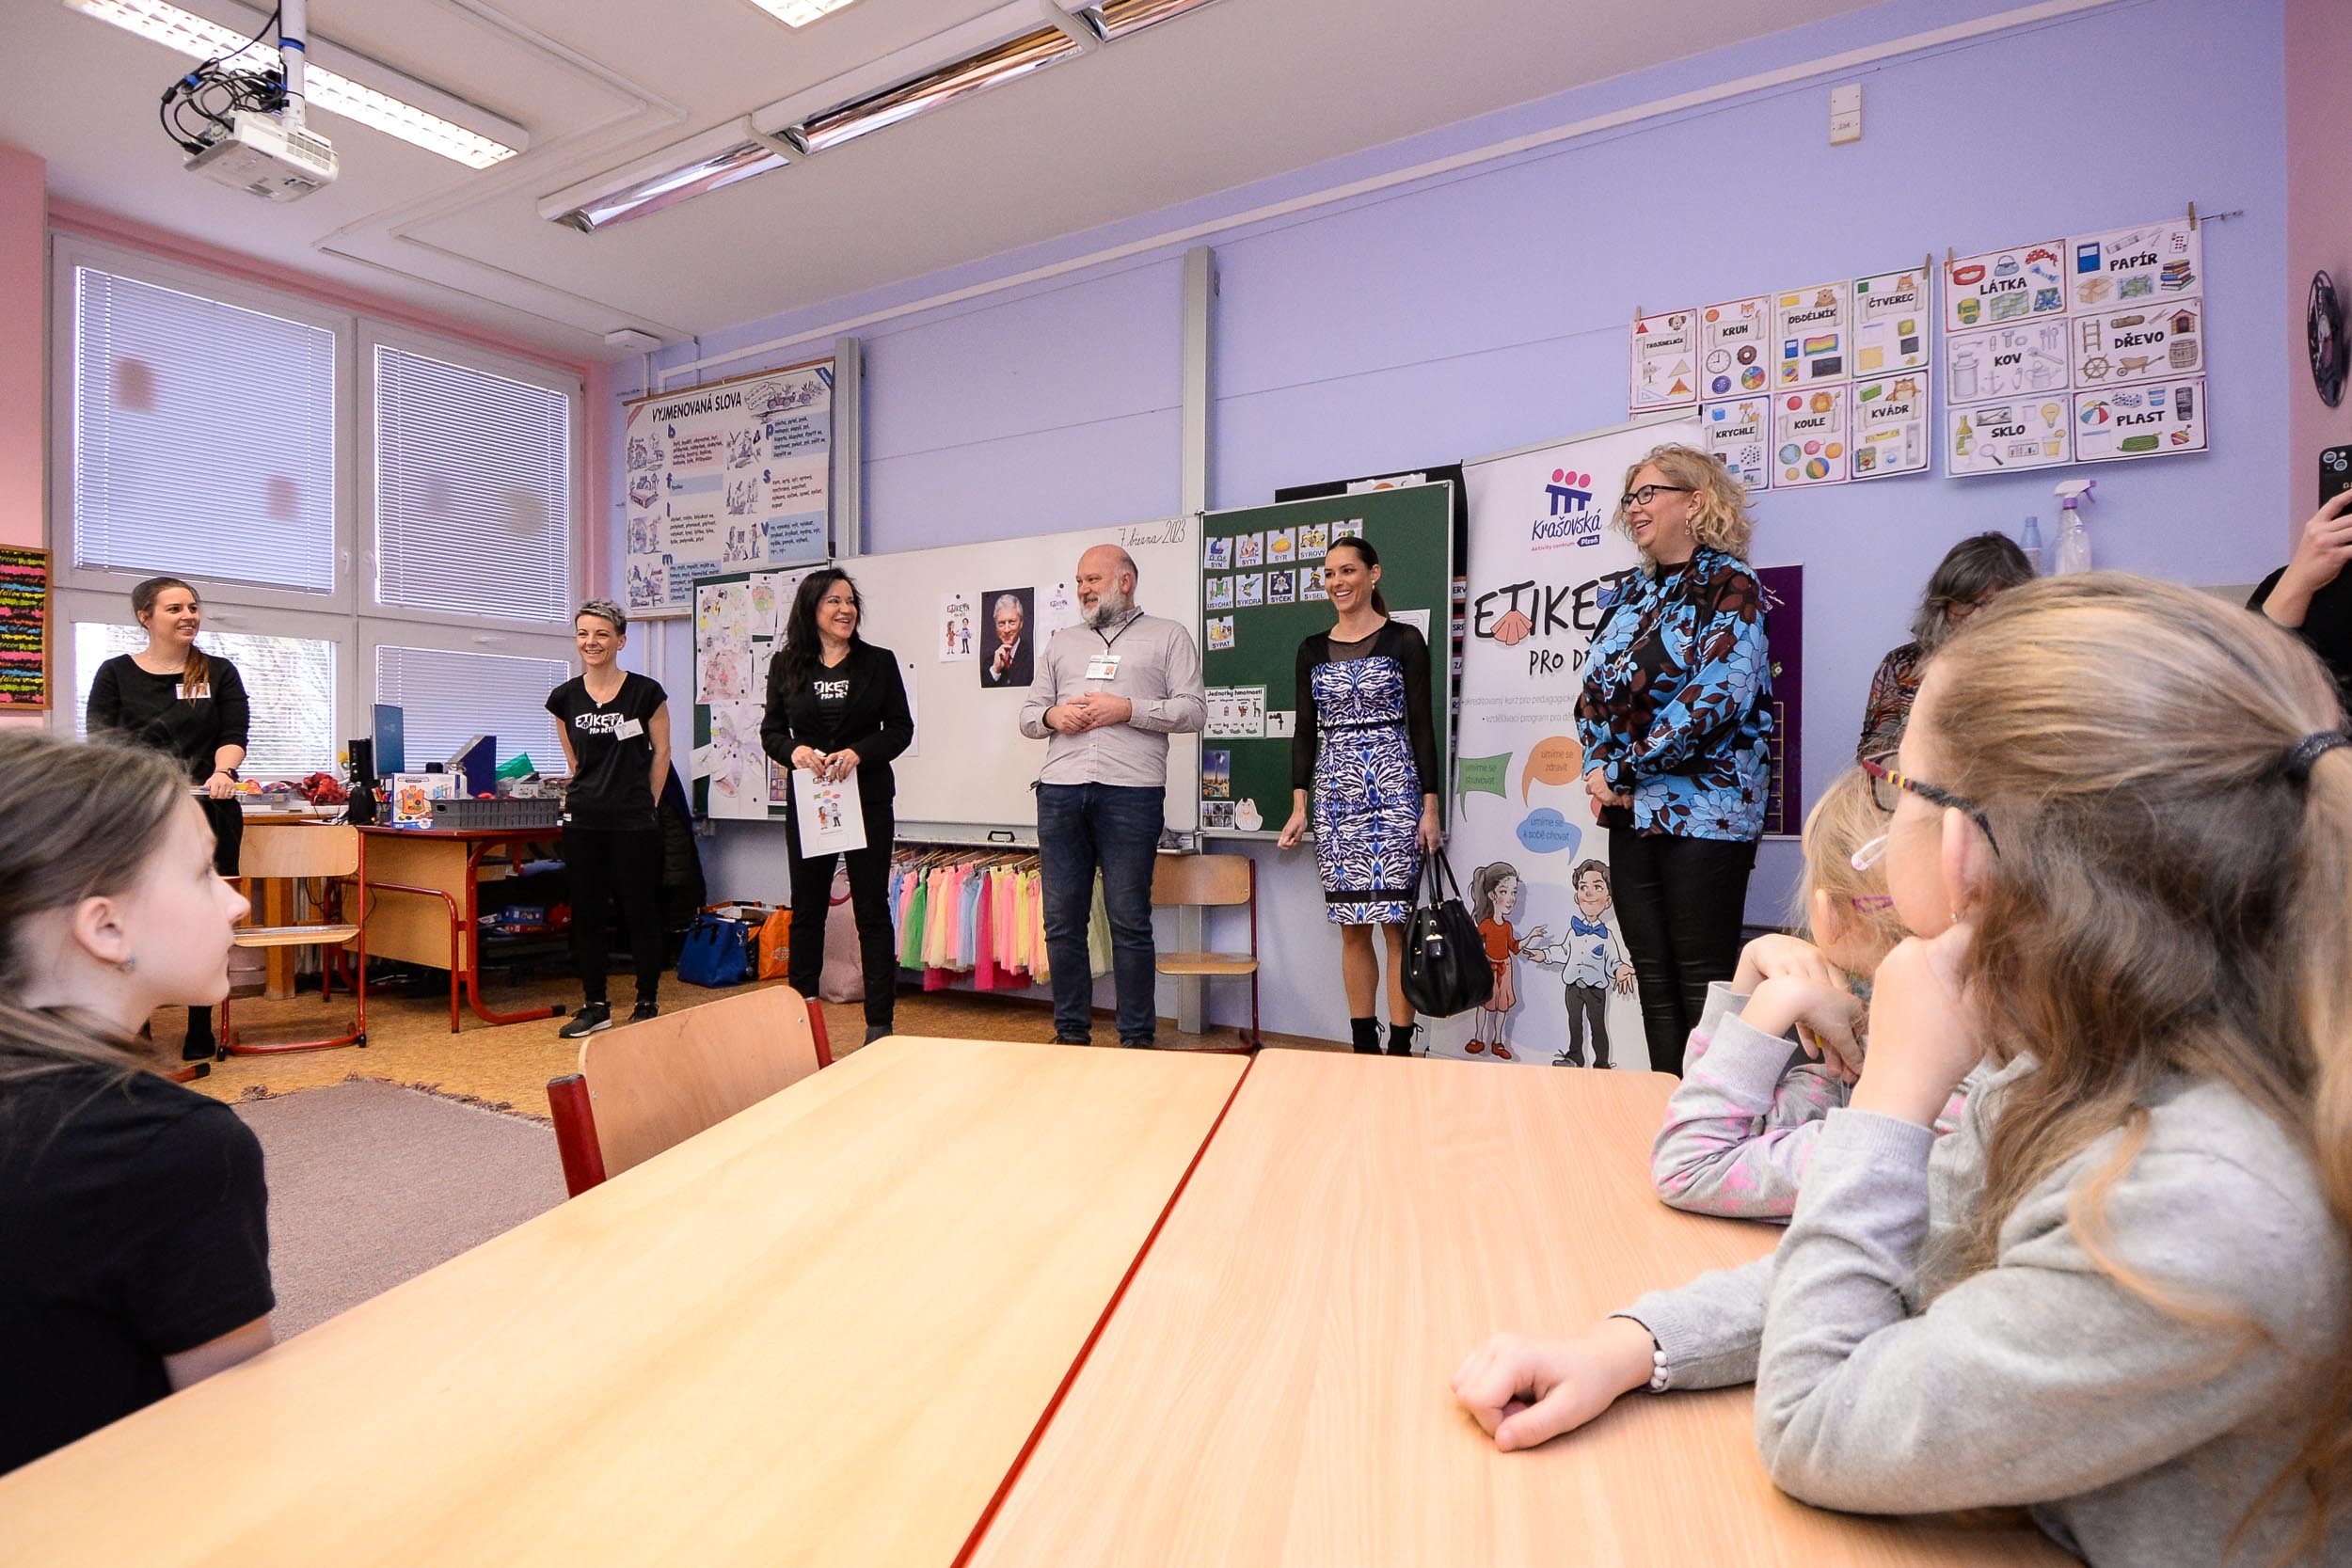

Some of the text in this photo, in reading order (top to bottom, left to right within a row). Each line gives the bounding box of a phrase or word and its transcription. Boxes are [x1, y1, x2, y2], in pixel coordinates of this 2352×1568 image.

[2110, 251, 2158, 272] PAPÍR
[1979, 277, 2027, 295] LÁTKA
[1869, 293, 1915, 309] ČTVEREC
[1788, 308, 1837, 325] OBDÉLNÍK
[1722, 325, 1749, 337] KRUH
[2114, 331, 2165, 349] DŘEVO
[1994, 353, 2022, 367] KOV
[652, 391, 742, 423] VYJMENOVANÁ SLOVA
[1871, 404, 1910, 419] KVÁDR
[1794, 417, 1826, 429] KOULE
[2117, 410, 2166, 427] PLAST
[668, 423, 675, 438] b
[1716, 426, 1756, 439] KRYCHLE
[1991, 424, 2026, 438] SKLO
[1532, 508, 1602, 541] Krašovská
[1581, 536, 1597, 545] Plzeň
[662, 554, 673, 565] m
[1474, 566, 1641, 639] ETIKET
[1530, 649, 1564, 675] PRO
